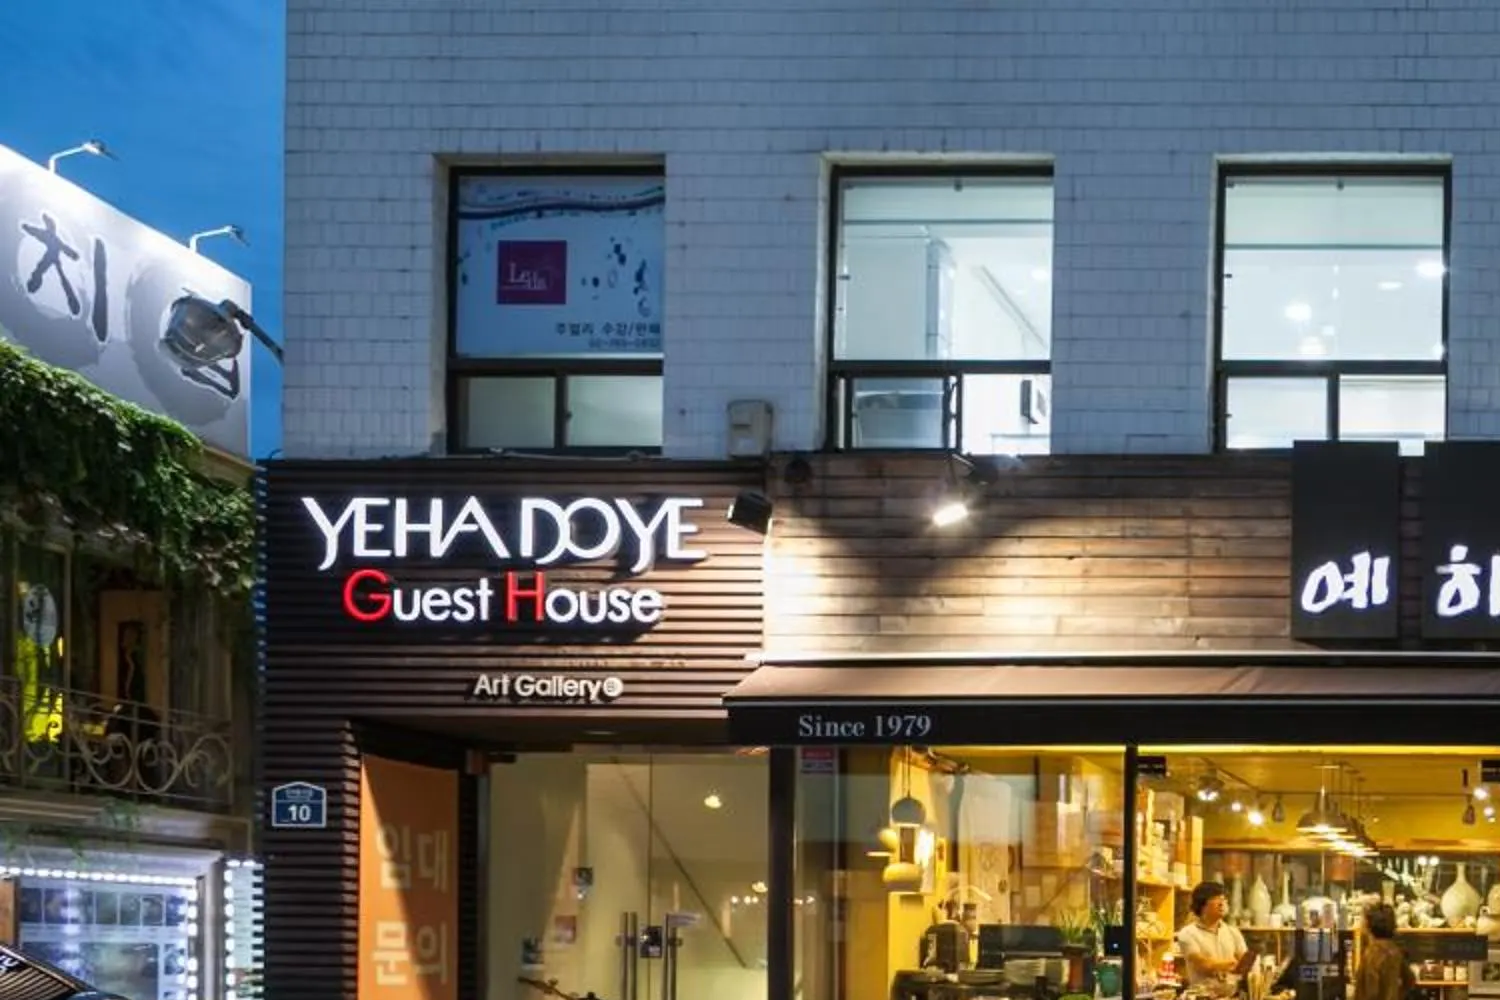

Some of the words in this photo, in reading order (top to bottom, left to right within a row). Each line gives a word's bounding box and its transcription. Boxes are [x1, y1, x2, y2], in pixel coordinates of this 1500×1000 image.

[301, 496, 511, 571] YEHA
[519, 497, 709, 574] DOYE
[343, 568, 494, 622] Guest
[506, 570, 664, 623] House
[473, 673, 510, 696] Art
[514, 674, 602, 701] Gallery
[799, 715, 865, 737] Since
[874, 715, 931, 737] 1979
[288, 804, 311, 822] 10
[374, 824, 448, 893] 임대
[372, 919, 448, 986] 문의
